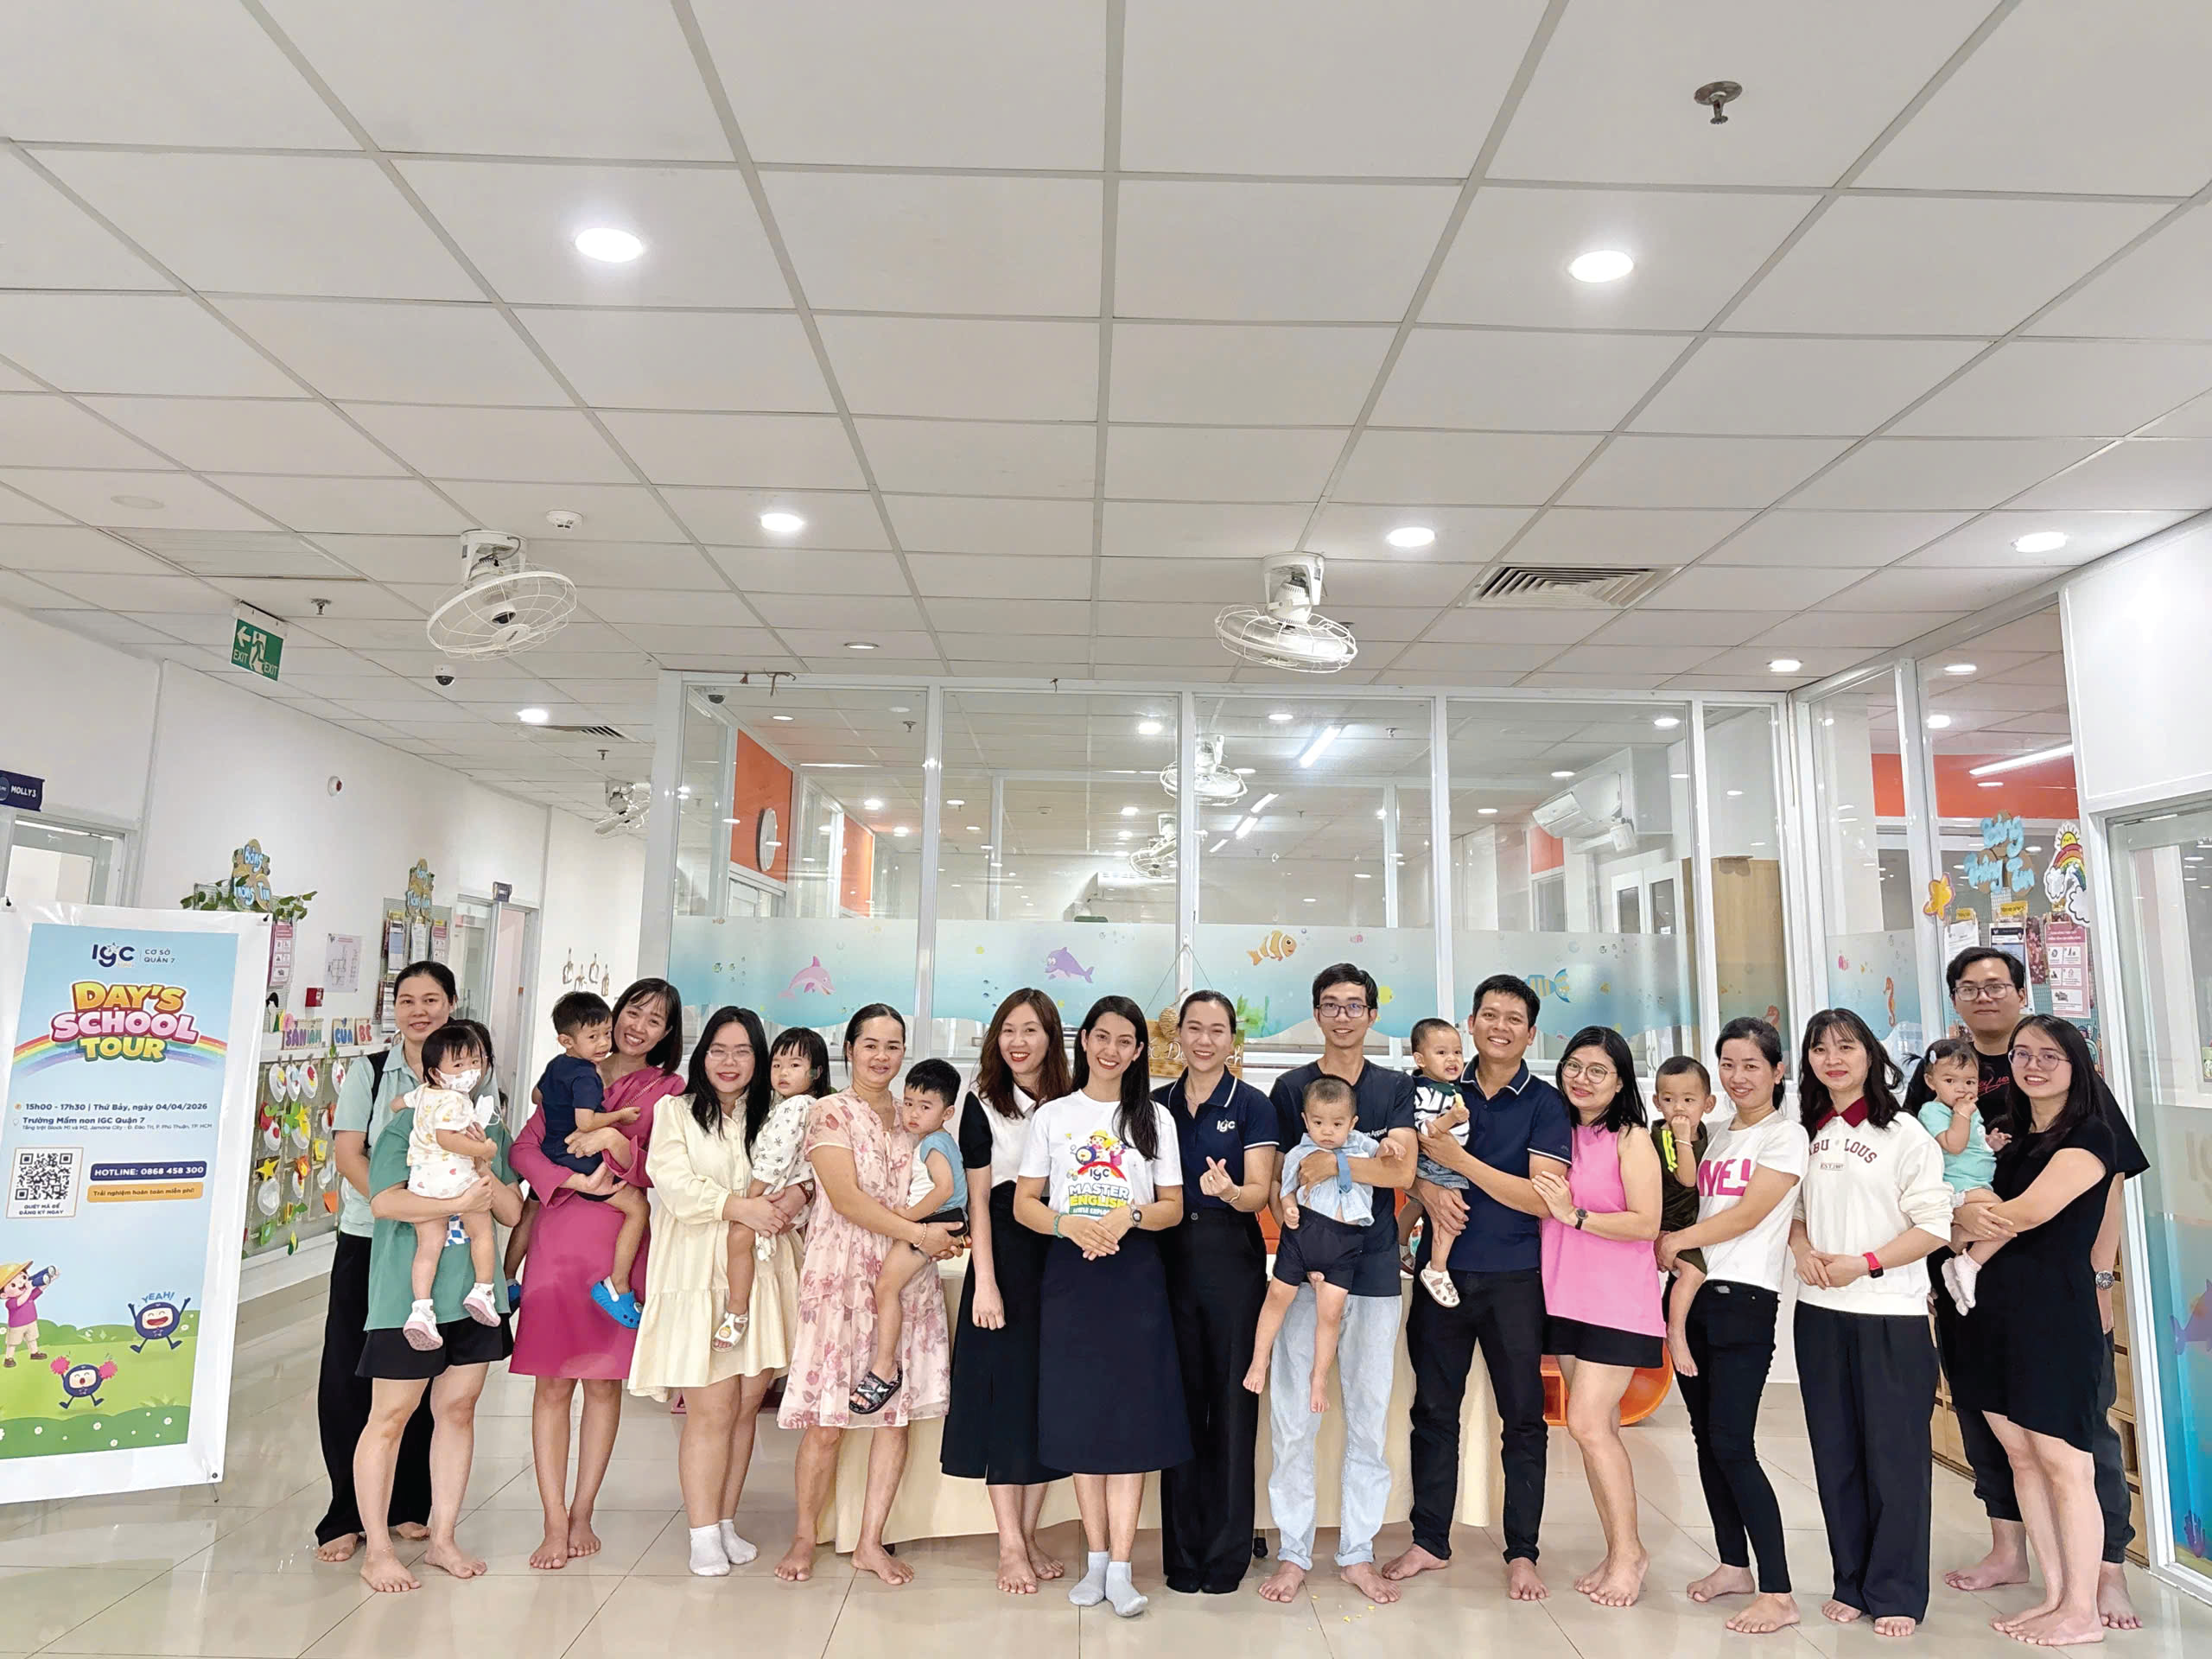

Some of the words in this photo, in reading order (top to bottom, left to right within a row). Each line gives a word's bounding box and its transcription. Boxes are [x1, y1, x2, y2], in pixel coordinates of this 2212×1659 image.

[233, 649, 248, 664] EXIT
[264, 661, 278, 676] EXIT
[73, 982, 186, 1013] DAY'S
[52, 1011, 199, 1044] SCHOOL
[79, 1036, 167, 1062] TOUR
[1068, 1183, 1129, 1200] MASTER
[1070, 1195, 1128, 1209] ENGLISH
[141, 1291, 175, 1303] YEAH!
